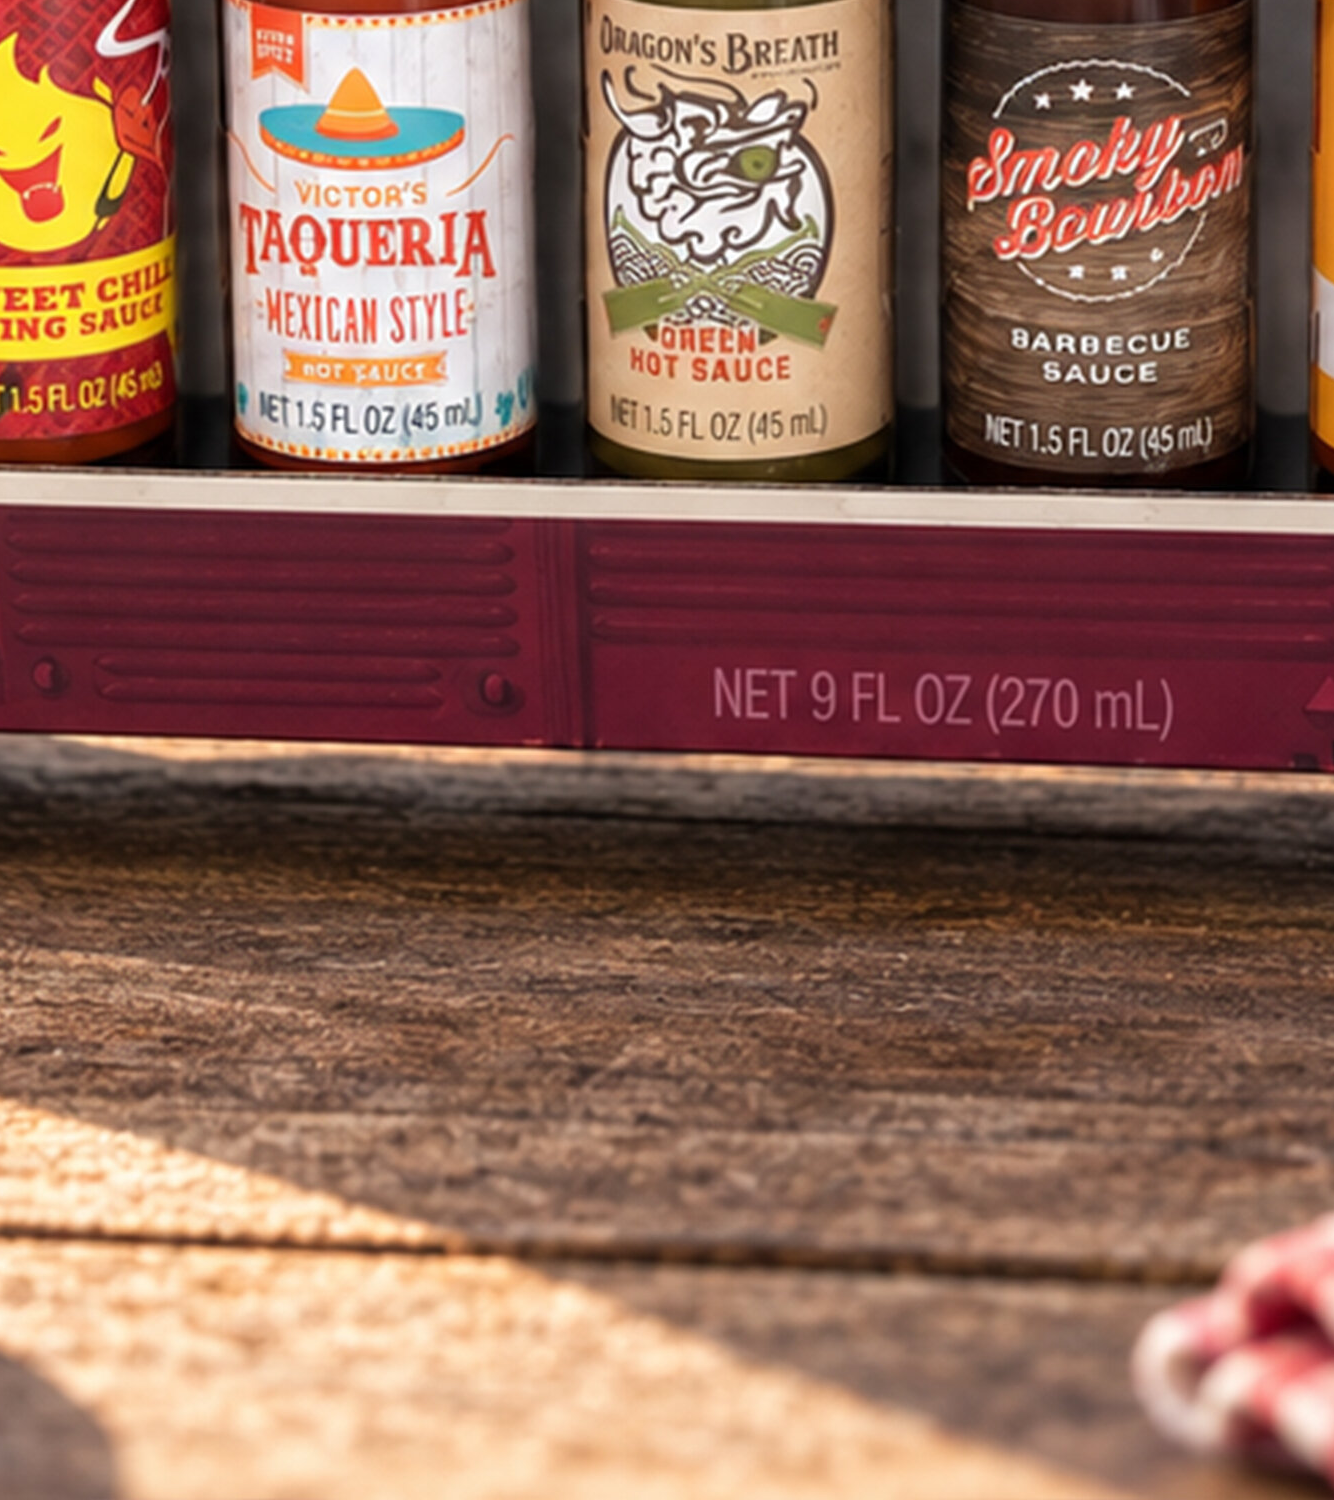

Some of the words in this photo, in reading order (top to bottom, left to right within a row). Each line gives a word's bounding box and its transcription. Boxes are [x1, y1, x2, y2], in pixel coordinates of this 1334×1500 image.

[722, 30, 838, 75] BREATH
[968, 115, 1185, 212] Smoky
[294, 180, 427, 208] VICTOR'S
[239, 202, 496, 278] TAQUERIA
[266, 288, 377, 343] MEXICAN
[390, 288, 468, 343] STYLE
[660, 326, 756, 354] GREEN
[1011, 327, 1191, 356] BARBECUE
[630, 347, 679, 379] HOT
[692, 355, 791, 383] SAUCE
[1042, 360, 1158, 385] SAUCE
[10, 385, 44, 414] 1.5
[48, 384, 75, 411] FL
[259, 391, 289, 427] NET
[296, 401, 326, 431] 1.5
[331, 404, 358, 434] FL
[364, 405, 395, 435] OZ
[402, 402, 439, 437] (45
[643, 405, 673, 436] 1.5
[678, 410, 705, 440] FL
[710, 411, 742, 442] OZ
[748, 410, 784, 445] (45
[790, 403, 828, 437] mL)
[985, 413, 1024, 448] NET
[1029, 423, 1062, 456] 1.5
[1069, 427, 1098, 456] FL
[1102, 427, 1134, 458] OZ
[1140, 424, 1174, 461] (45
[1178, 416, 1213, 451] mL)
[714, 667, 797, 720] NET
[810, 670, 837, 721] 9
[852, 672, 901, 723] FL
[914, 673, 972, 726] OZ
[986, 673, 1079, 735] (270
[1094, 678, 1174, 742] mL)
